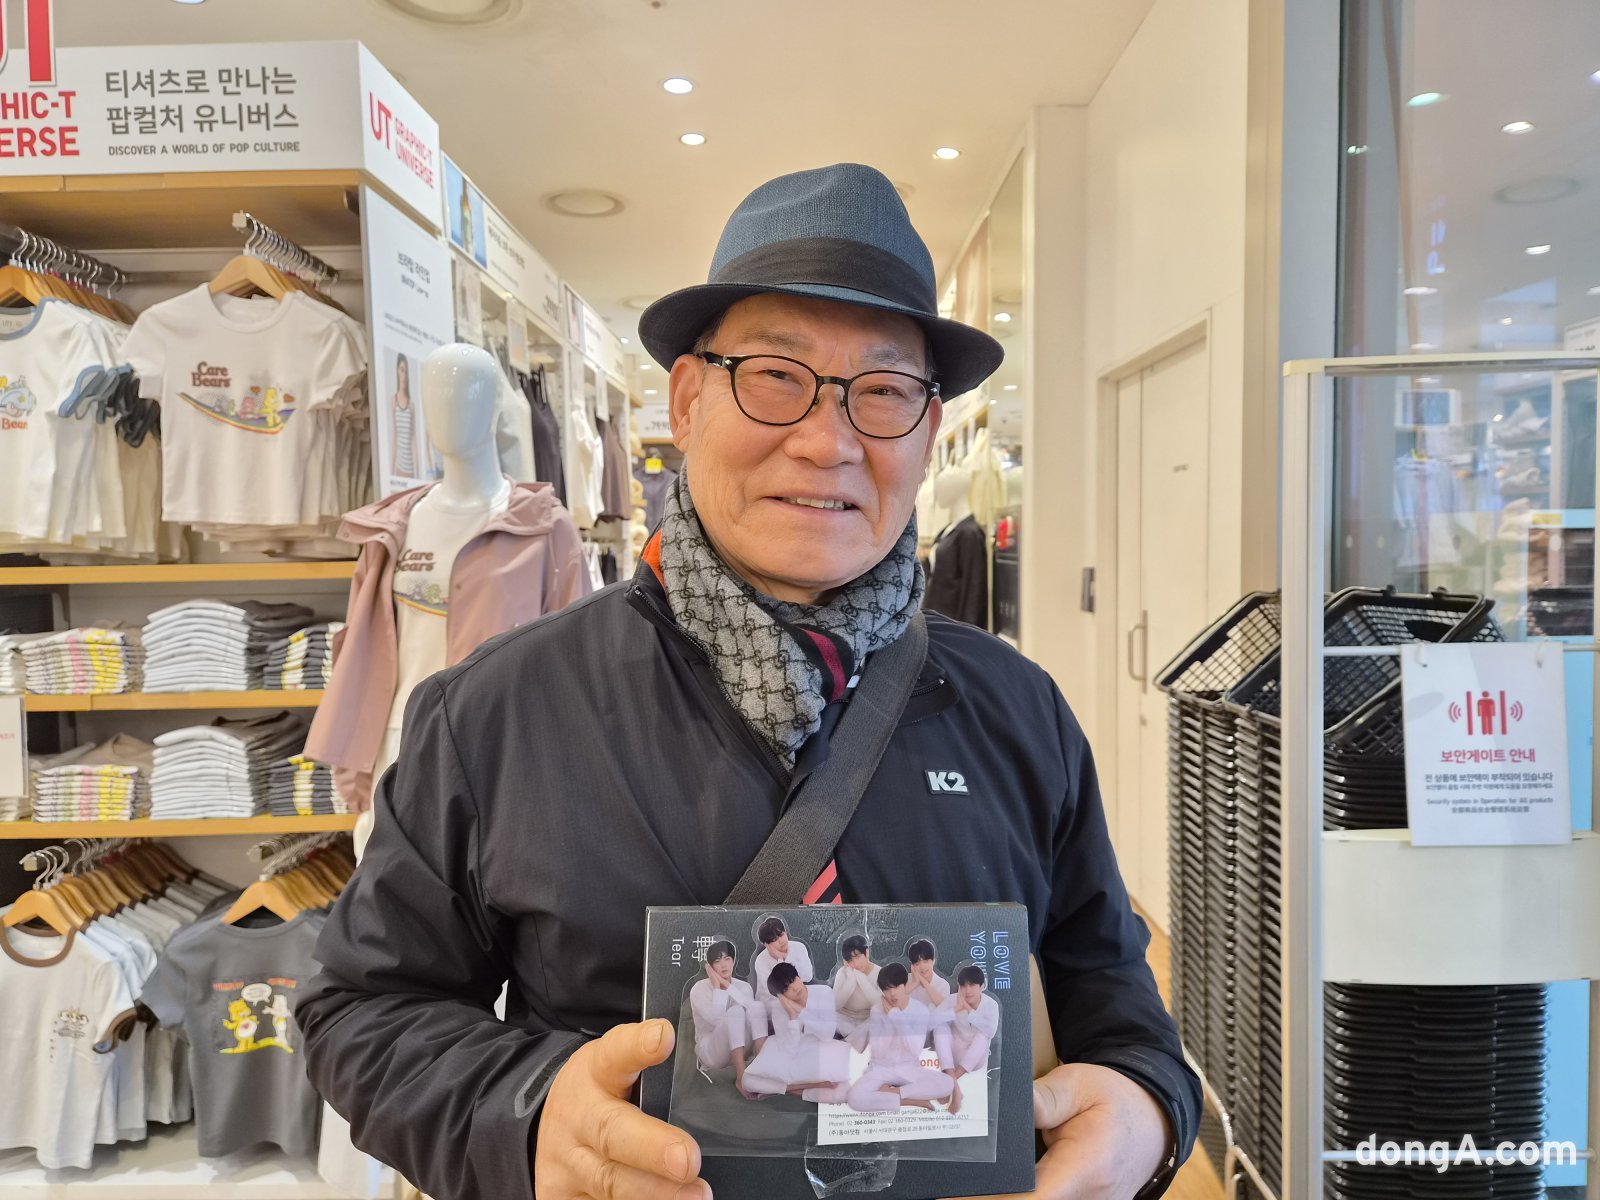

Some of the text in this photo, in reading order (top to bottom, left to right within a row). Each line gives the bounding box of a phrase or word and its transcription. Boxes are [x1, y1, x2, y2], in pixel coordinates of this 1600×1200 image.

[105, 66, 297, 98] 티셔츠로 만나는
[106, 102, 299, 135] 팝컬처 유니버스
[369, 91, 392, 150] UT
[108, 141, 300, 156] DISCOVER A WORLD OF POP CULTURE
[395, 140, 434, 189] UNIVERSE
[197, 361, 229, 377] Care
[191, 372, 232, 388] Bears
[402, 549, 434, 561] Care
[1441, 748, 1536, 763] 보안게이트 안내
[927, 771, 968, 792] K2
[1522, 772, 1553, 782] 있습니다
[1481, 797, 1507, 805] Operation
[1529, 797, 1553, 805] products
[671, 935, 684, 967] Tear
[993, 931, 1010, 990] LOVE
